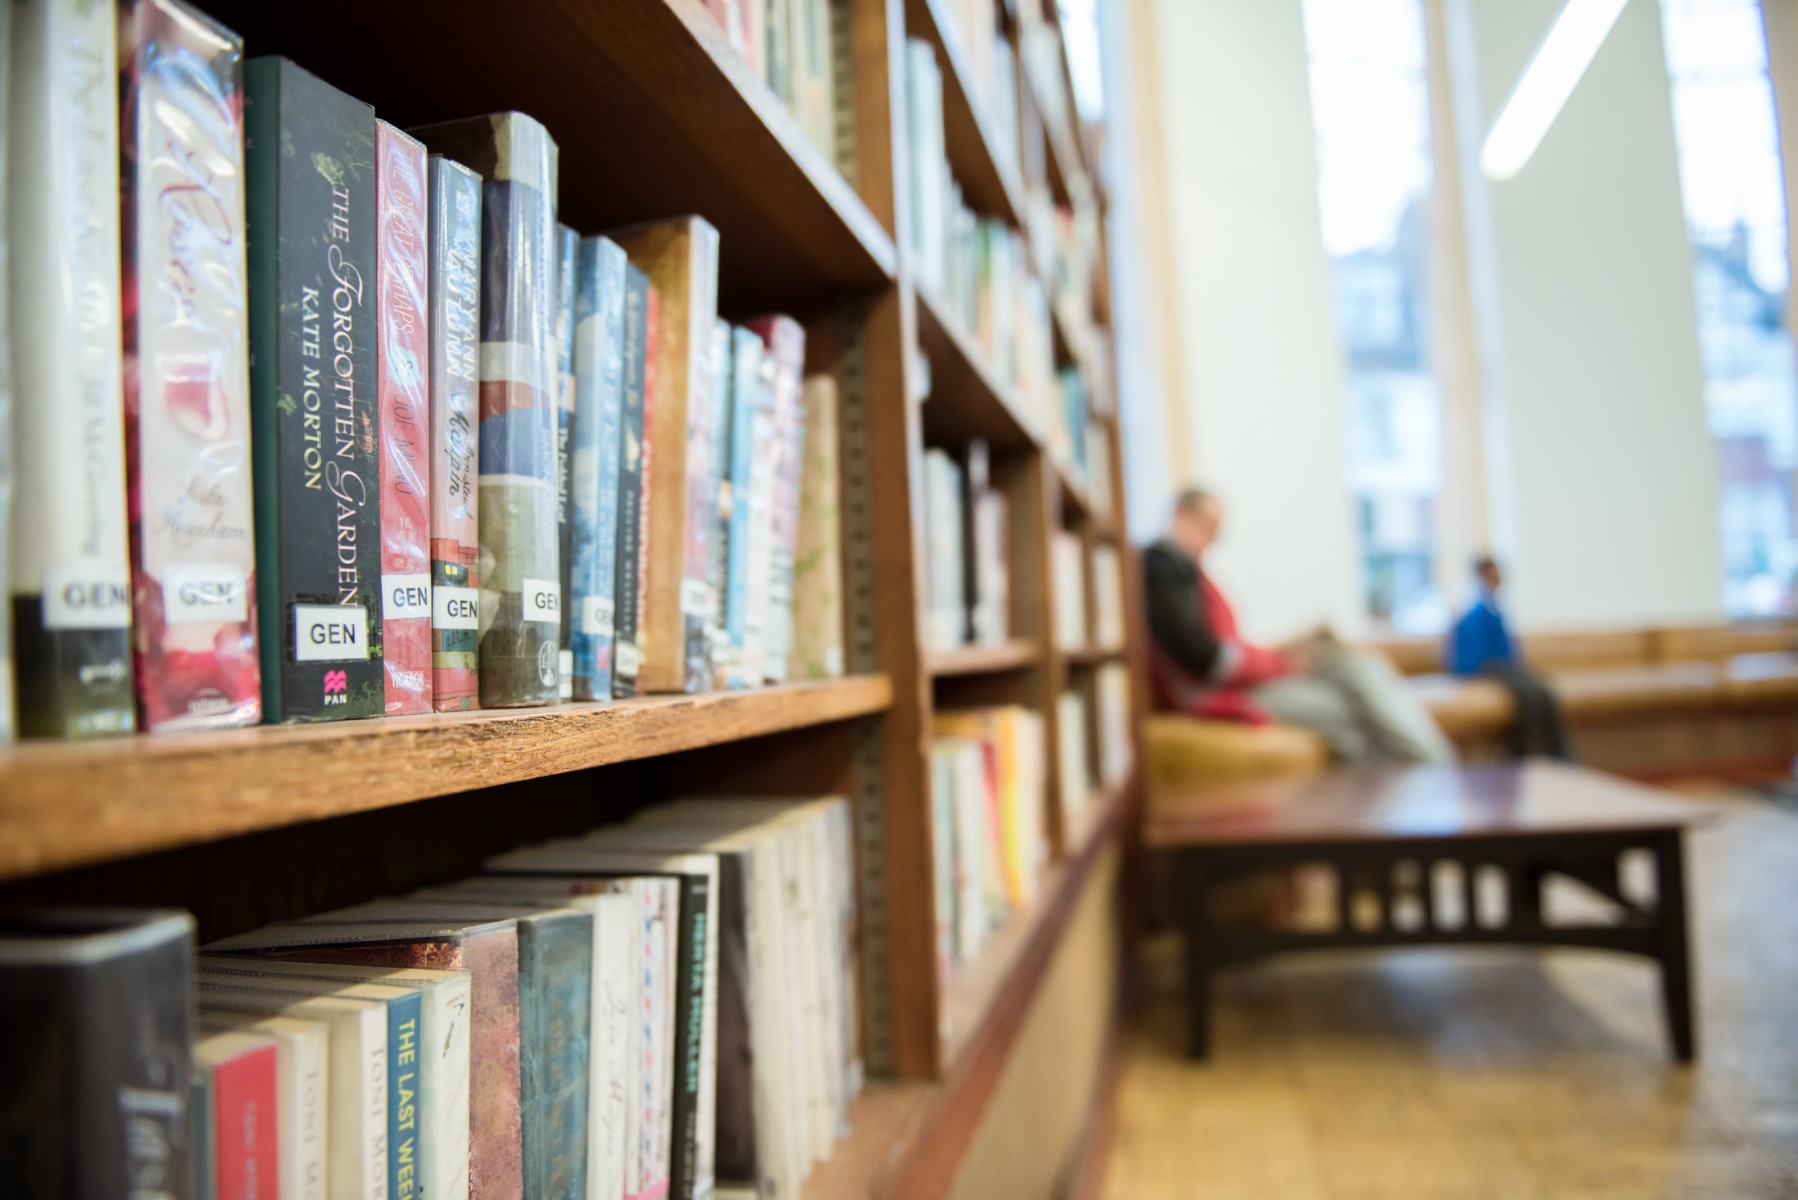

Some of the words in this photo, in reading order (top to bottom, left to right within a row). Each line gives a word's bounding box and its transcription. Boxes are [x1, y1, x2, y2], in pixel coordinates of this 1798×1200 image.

[393, 152, 414, 187] THE
[333, 188, 350, 243] THE
[393, 188, 414, 251] GREAT
[302, 285, 320, 359] KATE
[328, 244, 363, 460] FORGOTTEN
[463, 330, 477, 382] ANN
[303, 365, 321, 491] MORTON
[394, 395, 415, 431] JOE
[326, 460, 366, 606] GARDEN
[393, 587, 428, 607] GEN
[447, 599, 478, 618] GEN
[310, 623, 356, 644] GEN
[324, 694, 347, 705] PAN
[399, 1018, 415, 1067] THE
[371, 1046, 387, 1117] TONI
[398, 1072, 414, 1131] LAST
